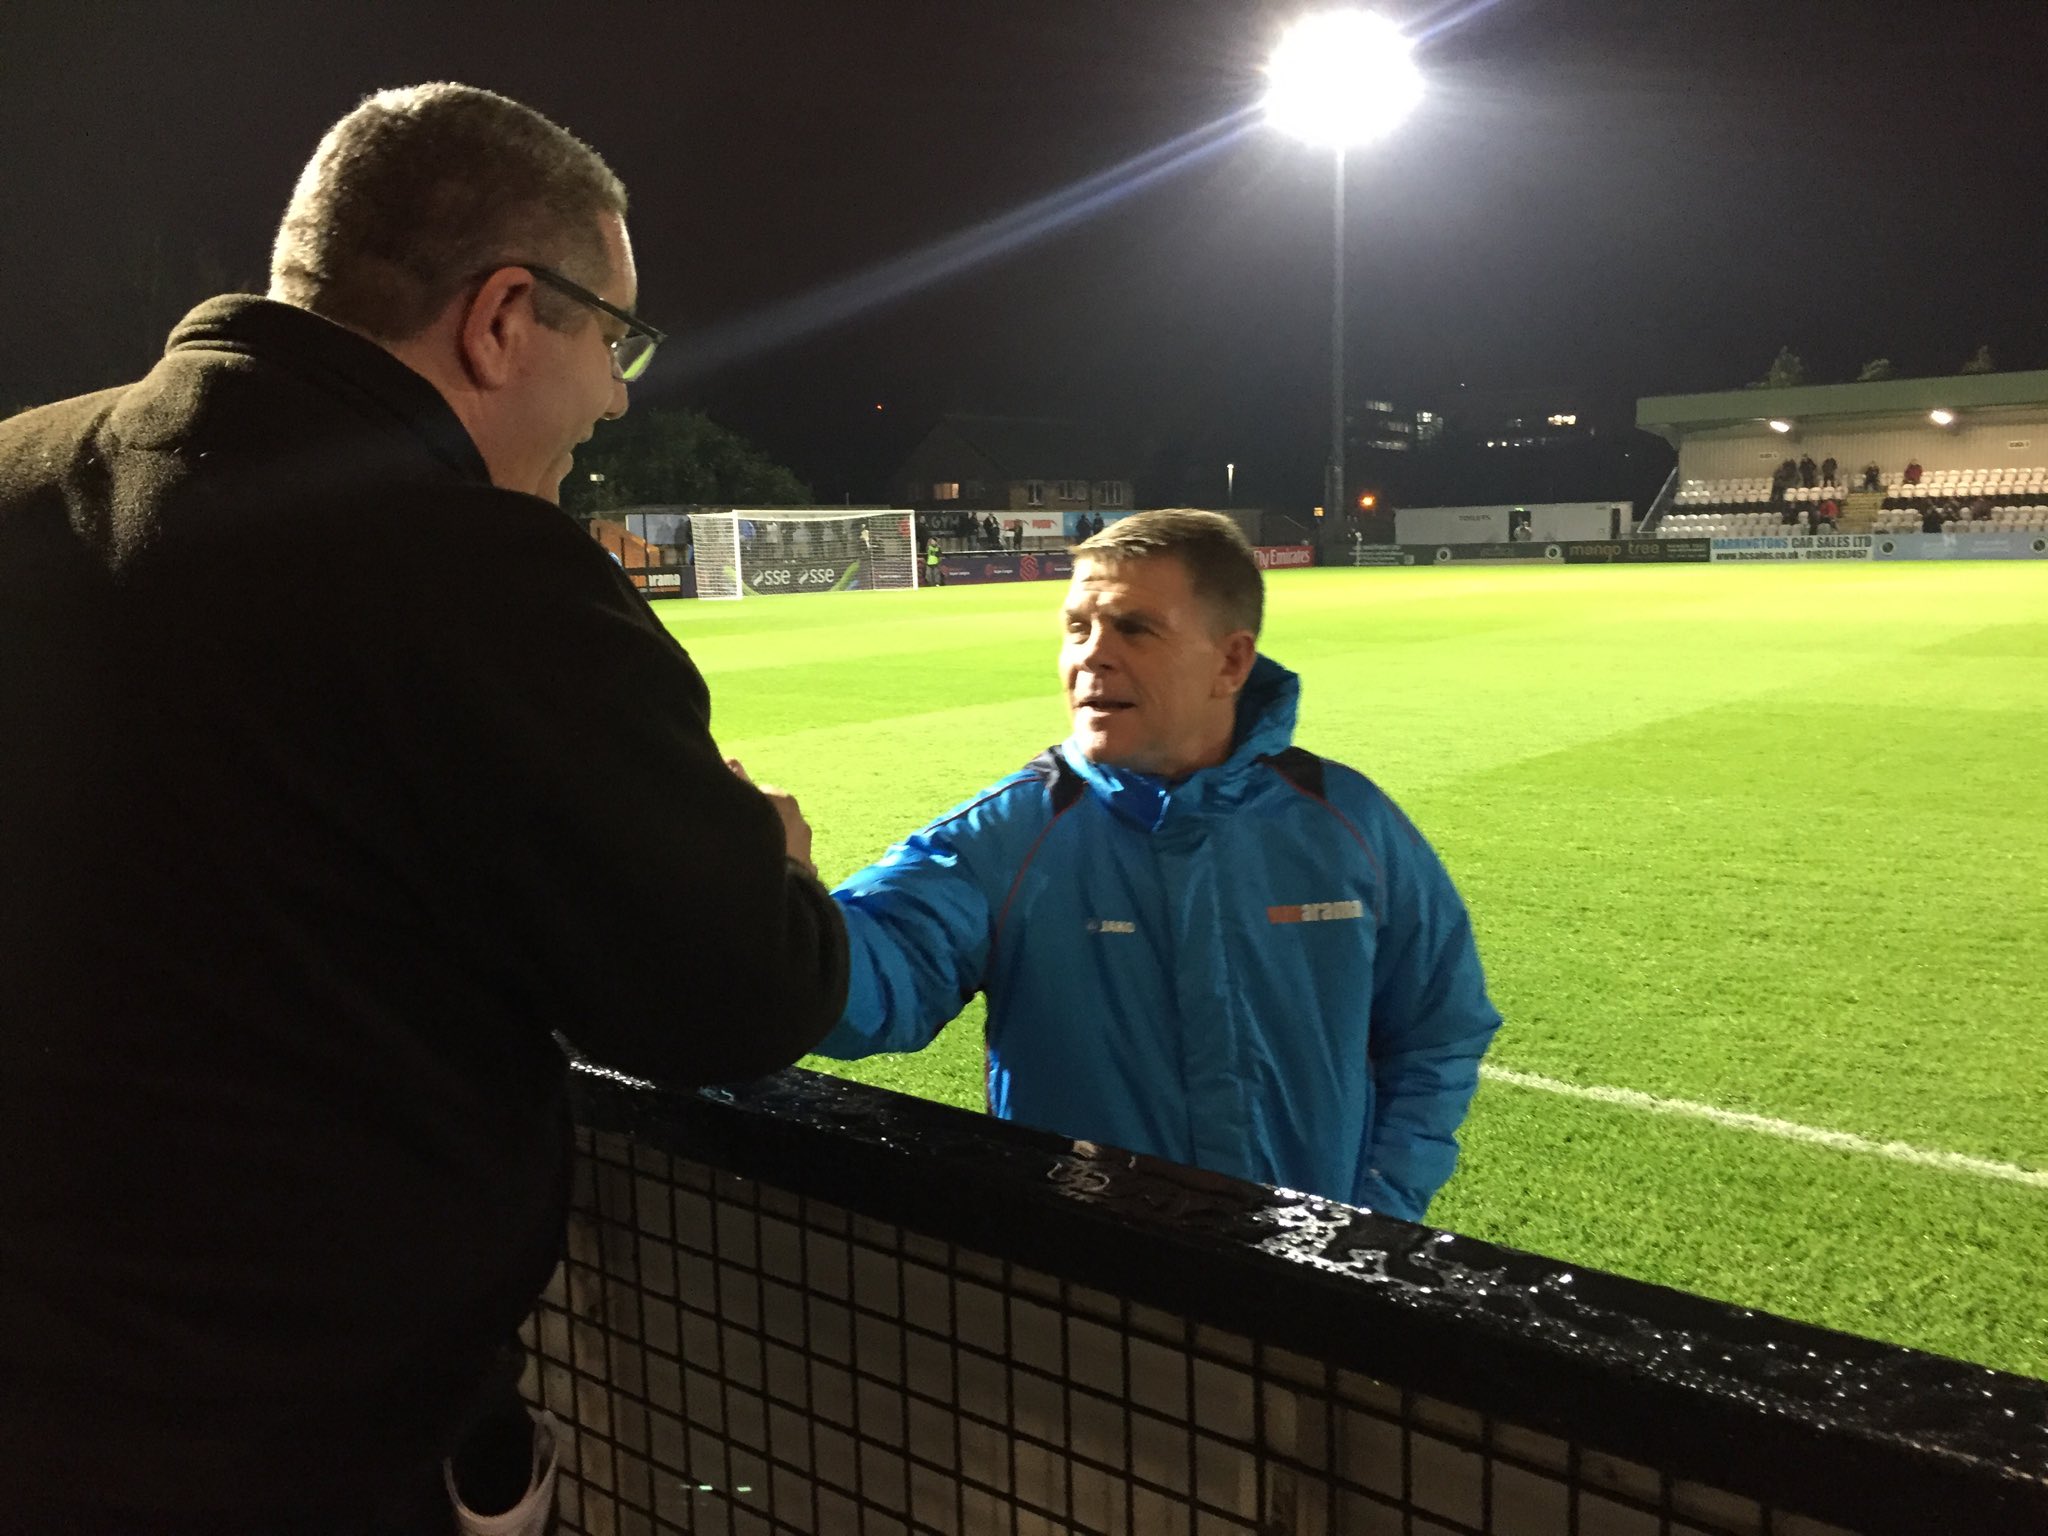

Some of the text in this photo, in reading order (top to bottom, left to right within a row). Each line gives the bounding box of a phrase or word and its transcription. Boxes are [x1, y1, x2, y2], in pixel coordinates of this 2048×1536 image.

[1628, 542, 1660, 555] tree
[1791, 537, 1814, 549] CAR
[1817, 536, 1850, 548] SALES
[1853, 535, 1872, 547] LTD
[1270, 548, 1311, 565] Emirates
[765, 569, 791, 585] sse
[810, 568, 834, 583] sse
